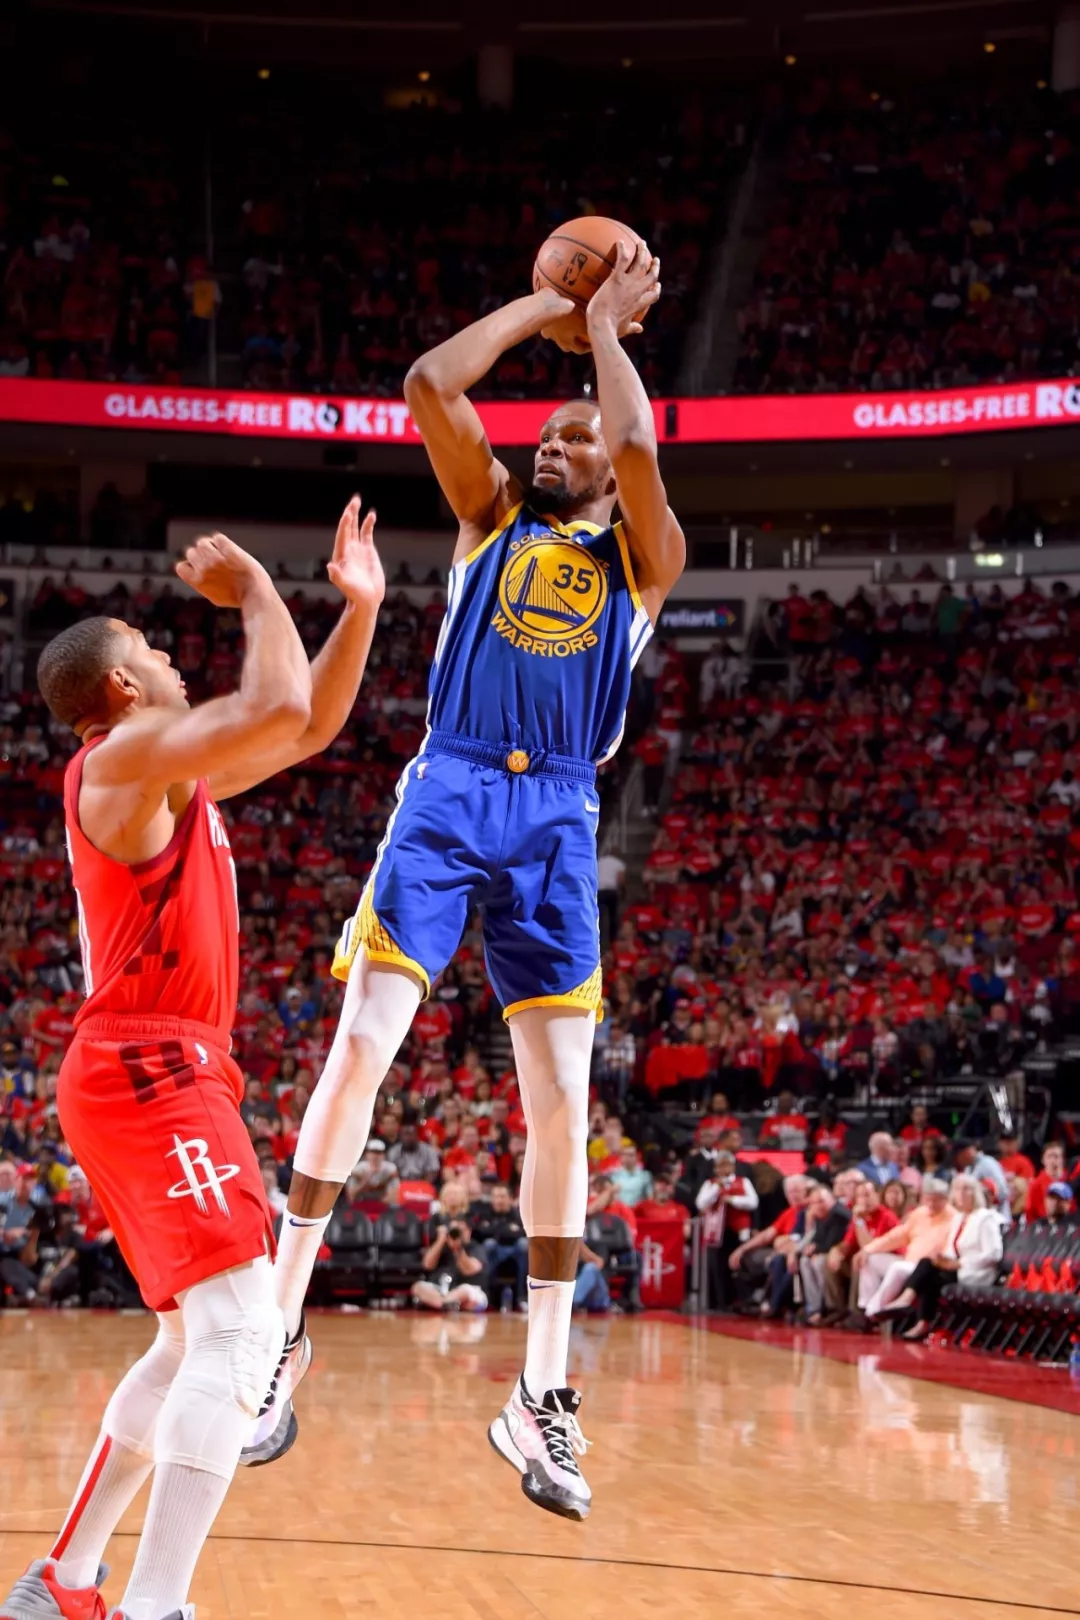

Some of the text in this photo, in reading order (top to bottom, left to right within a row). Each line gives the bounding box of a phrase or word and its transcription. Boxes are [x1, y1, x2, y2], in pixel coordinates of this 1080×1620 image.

[104, 393, 421, 437] GLASSES-FREE ROKiT
[853, 392, 1030, 428] GLASSES-FREE
[552, 563, 595, 594] 35
[490, 611, 599, 658] WARRIORS
[662, 608, 716, 627] reliant
